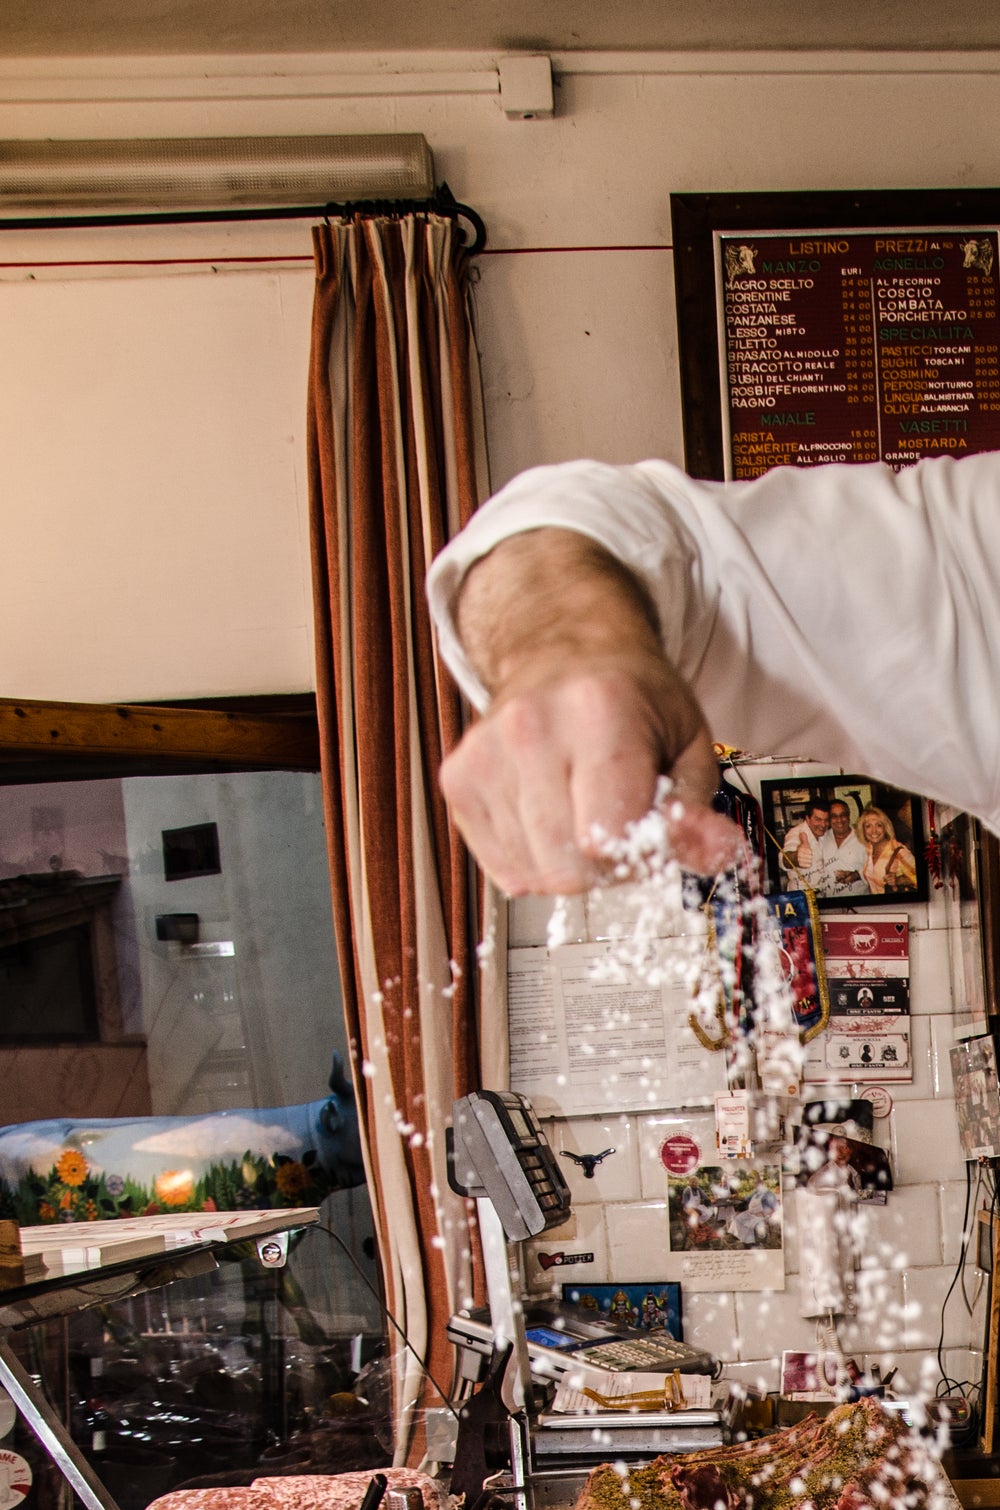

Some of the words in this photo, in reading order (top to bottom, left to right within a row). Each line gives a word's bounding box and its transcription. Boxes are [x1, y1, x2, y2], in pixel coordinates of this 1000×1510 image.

[790, 241, 849, 254] LISTINO
[875, 240, 928, 253] PREZZI
[930, 242, 940, 250] AL
[762, 260, 821, 273] MANZO
[873, 256, 945, 272] AGNELLO
[841, 268, 862, 276] EURI
[725, 280, 767, 291] MAGRO
[769, 279, 814, 290] SCELTO
[893, 278, 941, 286] PECORINO
[726, 291, 791, 303] FIORENTINE
[877, 288, 932, 298] COSCIO
[726, 303, 777, 314] COSTATA
[879, 300, 944, 311] LOMBATA
[727, 315, 797, 326] PANZANESE
[879, 310, 967, 322] PORCHETTATO
[728, 328, 768, 338] LESSO
[728, 338, 778, 350] FILETTO
[728, 350, 782, 361] BRASATO
[783, 350, 796, 358] AL
[882, 346, 933, 356] PASTICCI
[934, 346, 971, 354] TOSCANI
[729, 362, 803, 373] STRACOTTO
[804, 362, 836, 370] REALE
[882, 358, 917, 368] SUGHI
[924, 358, 965, 366] TOSCANI
[729, 374, 764, 384] SUSHI
[786, 374, 824, 382] CHIANTI
[882, 370, 940, 380] COSIMINO
[731, 385, 792, 397] ROSBIFFE
[792, 384, 846, 394] FIORENTINO
[884, 381, 928, 392] PEPOSO
[928, 381, 974, 390] NOTTURNO
[731, 396, 776, 408] RAGNO
[884, 393, 924, 403] LINGUA
[884, 404, 920, 414] OLIVE
[761, 412, 816, 426] MAIALE
[900, 420, 968, 432] VASETTI
[733, 432, 774, 442] ARISTA
[733, 443, 798, 454] SCAMERITE
[898, 438, 968, 448] MOSTARDA
[734, 455, 792, 466] SALSICCE
[885, 452, 920, 460] GRANDE
[563, 1254, 592, 1264] POTTER
